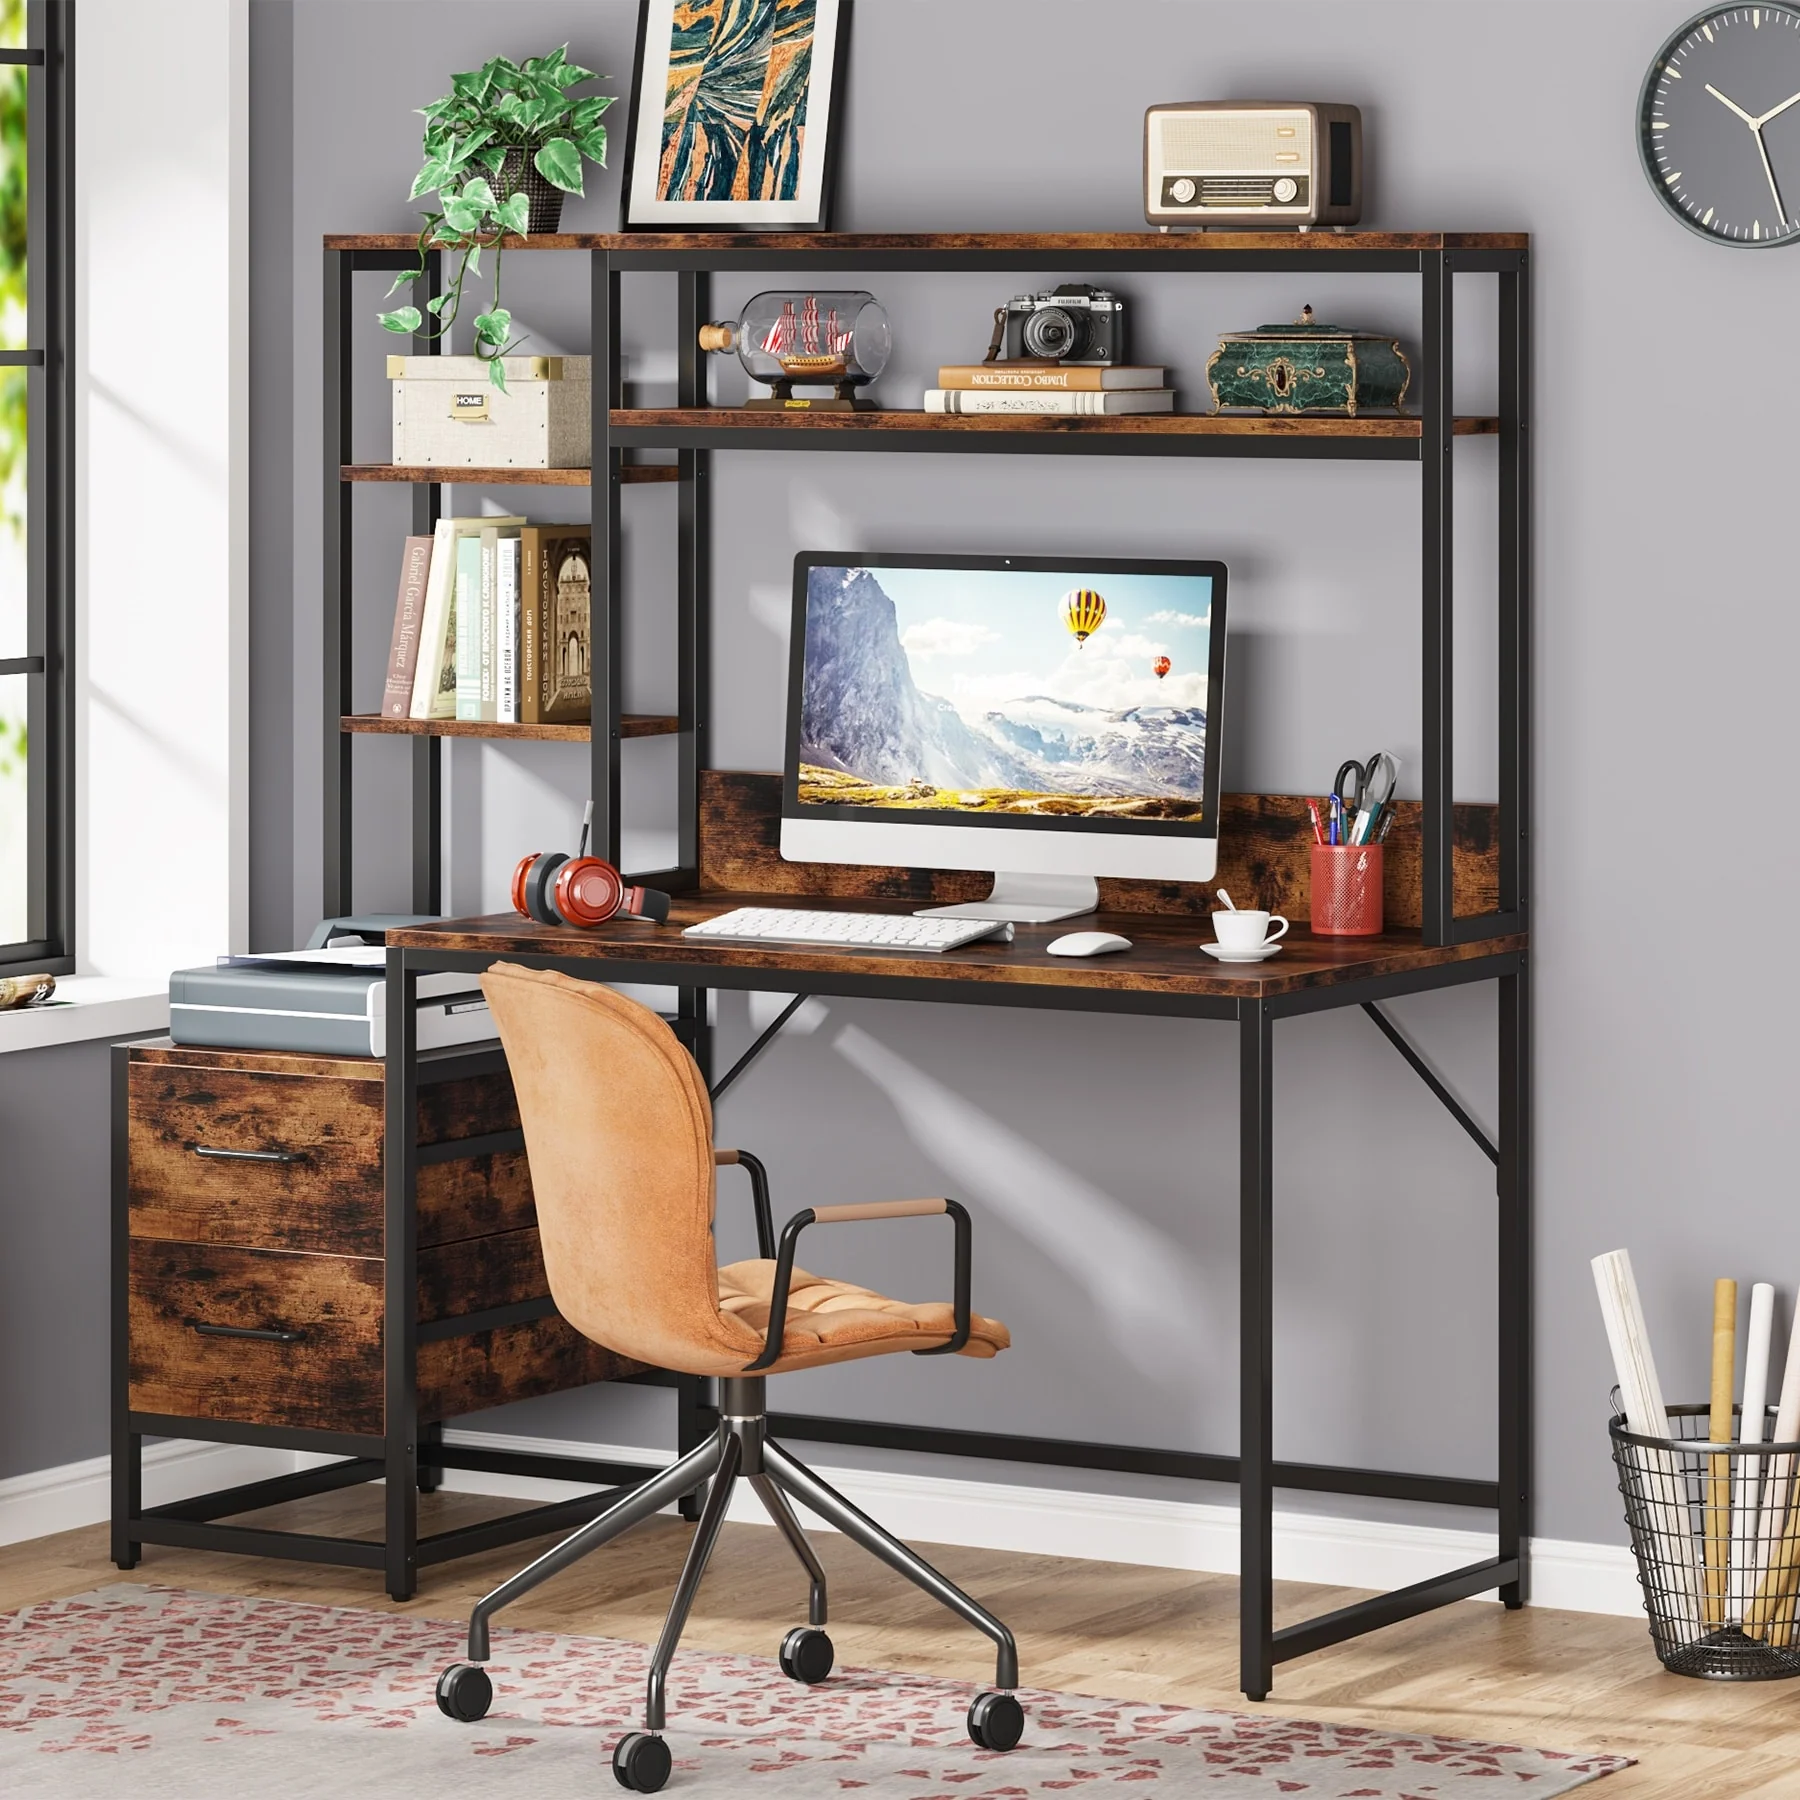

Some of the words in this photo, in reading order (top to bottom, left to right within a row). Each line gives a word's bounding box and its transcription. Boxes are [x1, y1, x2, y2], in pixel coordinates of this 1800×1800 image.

[971, 374, 1033, 387] COLLECTION
[1034, 373, 1068, 387] JUMBO
[457, 396, 482, 405] HOME
[406, 546, 426, 585] Gabriel
[402, 586, 421, 621] García
[482, 608, 490, 652] ПРОСТОГО
[395, 623, 416, 668] Márquez
[482, 653, 490, 667] ОТ
